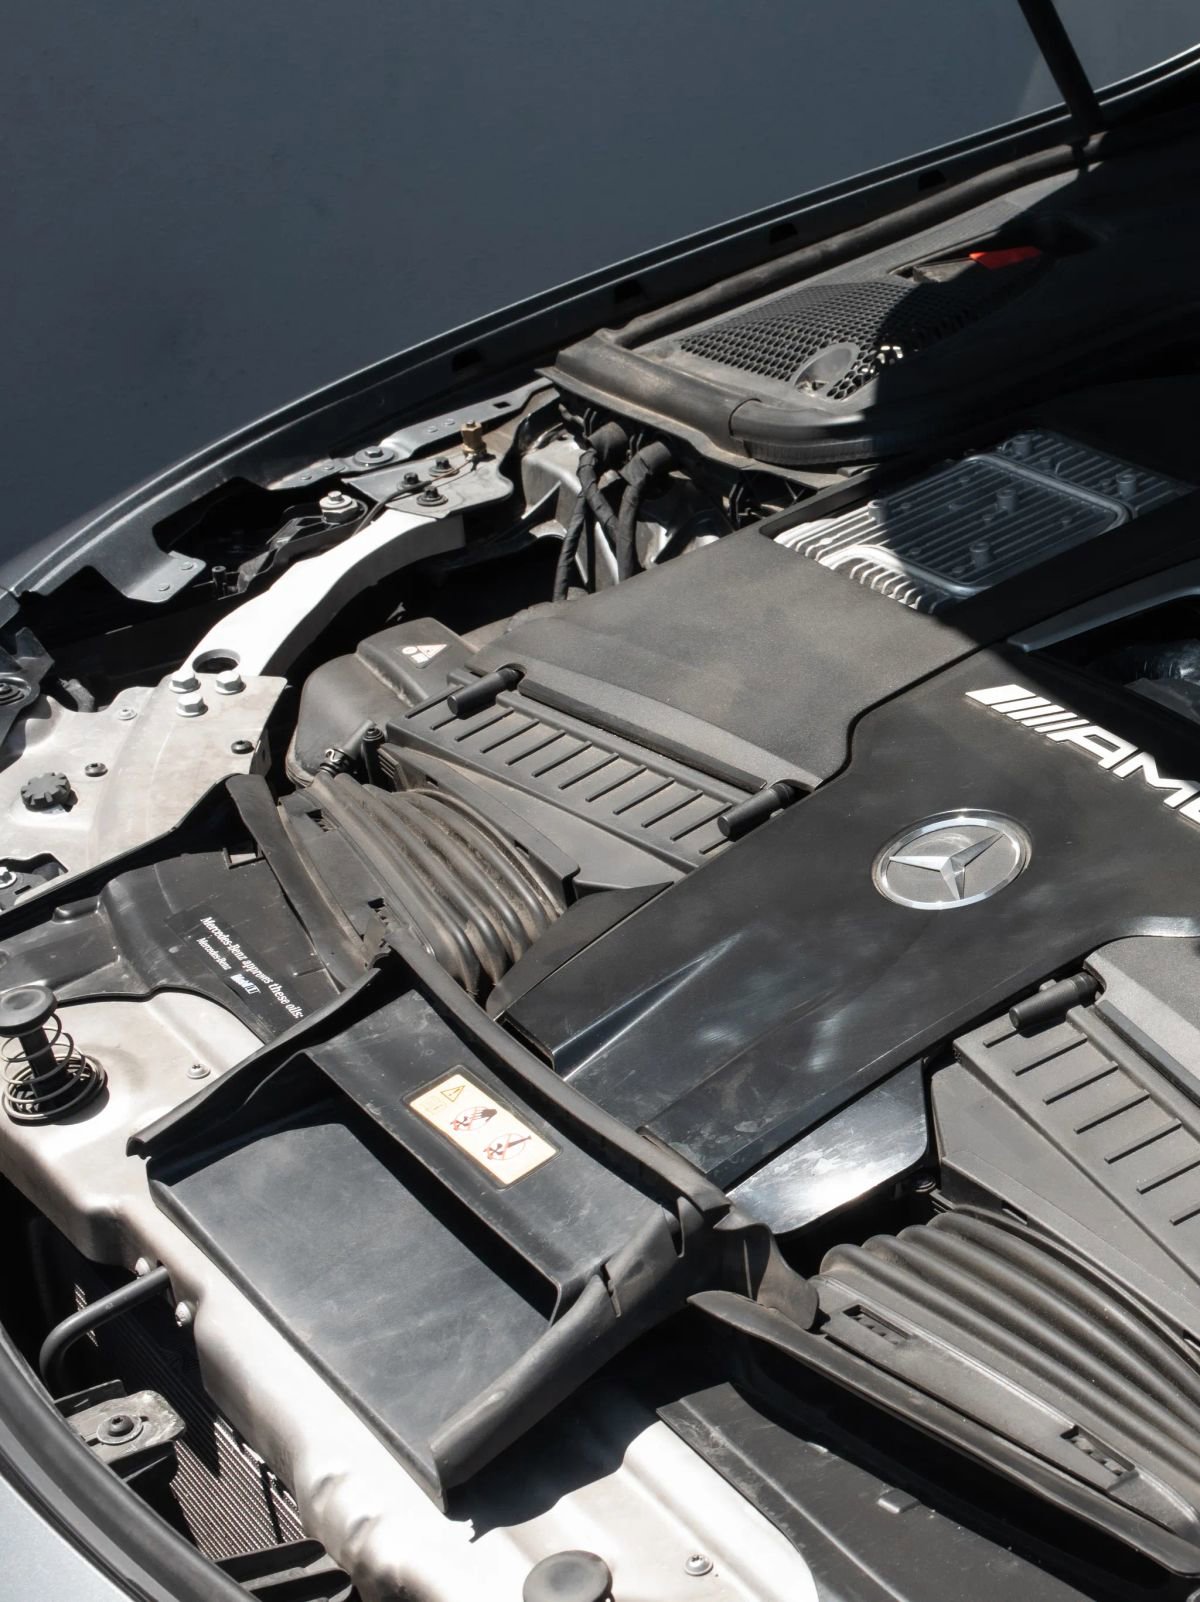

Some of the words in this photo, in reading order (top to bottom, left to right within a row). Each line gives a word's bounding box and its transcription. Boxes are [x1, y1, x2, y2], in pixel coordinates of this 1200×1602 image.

[196, 937, 232, 971] Mercedes-Benz
[200, 916, 248, 961] Mercedes-Benz
[241, 959, 274, 985] approves
[268, 981, 291, 1005] these
[285, 1001, 304, 1019] oils:
